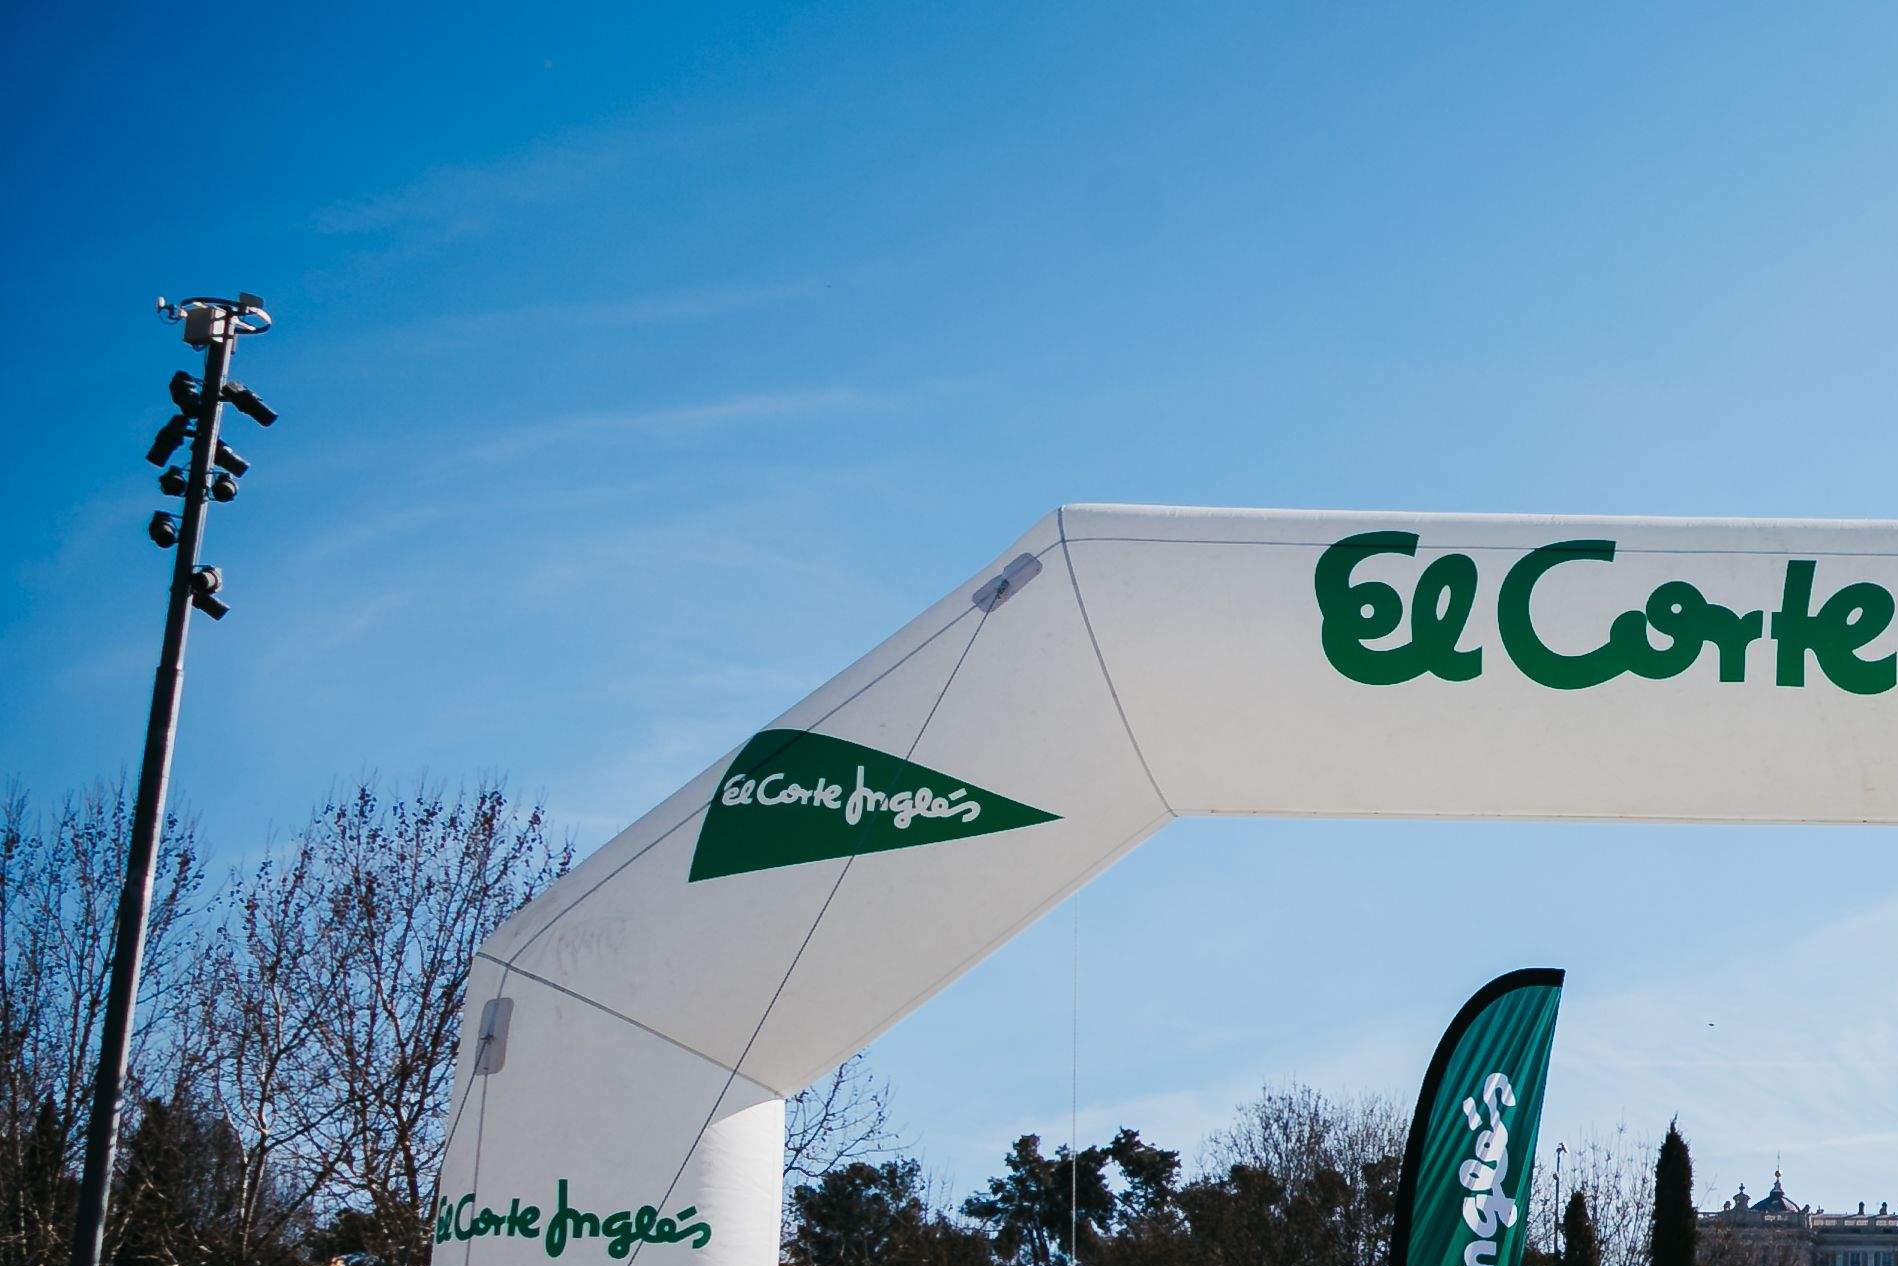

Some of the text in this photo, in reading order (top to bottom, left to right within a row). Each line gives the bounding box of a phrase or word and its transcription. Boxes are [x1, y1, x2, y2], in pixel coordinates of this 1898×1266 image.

[1314, 530, 1483, 686] El
[1497, 539, 1898, 695] Corte
[722, 765, 981, 829] El Corte Inglés
[455, 1193, 541, 1242] Corte
[545, 1178, 712, 1259] Inglés
